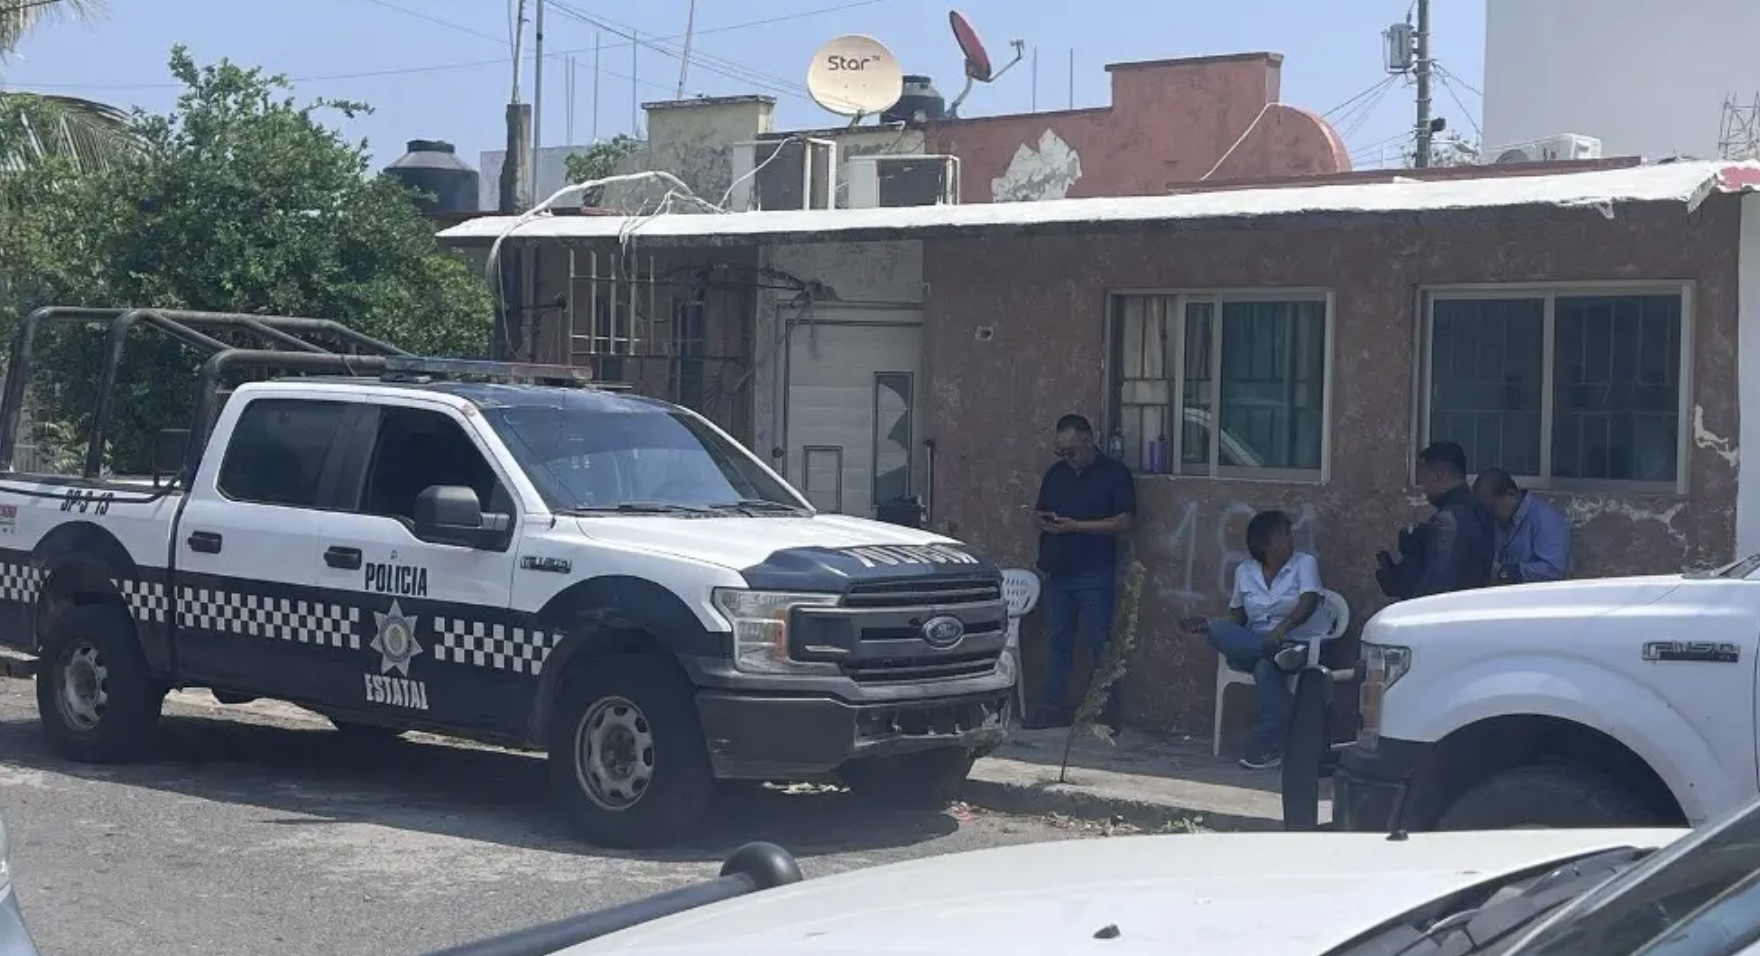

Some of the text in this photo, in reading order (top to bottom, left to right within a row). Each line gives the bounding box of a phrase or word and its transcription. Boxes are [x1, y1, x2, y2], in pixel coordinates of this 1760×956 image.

[828, 55, 871, 70] Star
[365, 562, 427, 597] POLICIA
[364, 673, 429, 710] ESTATAL
